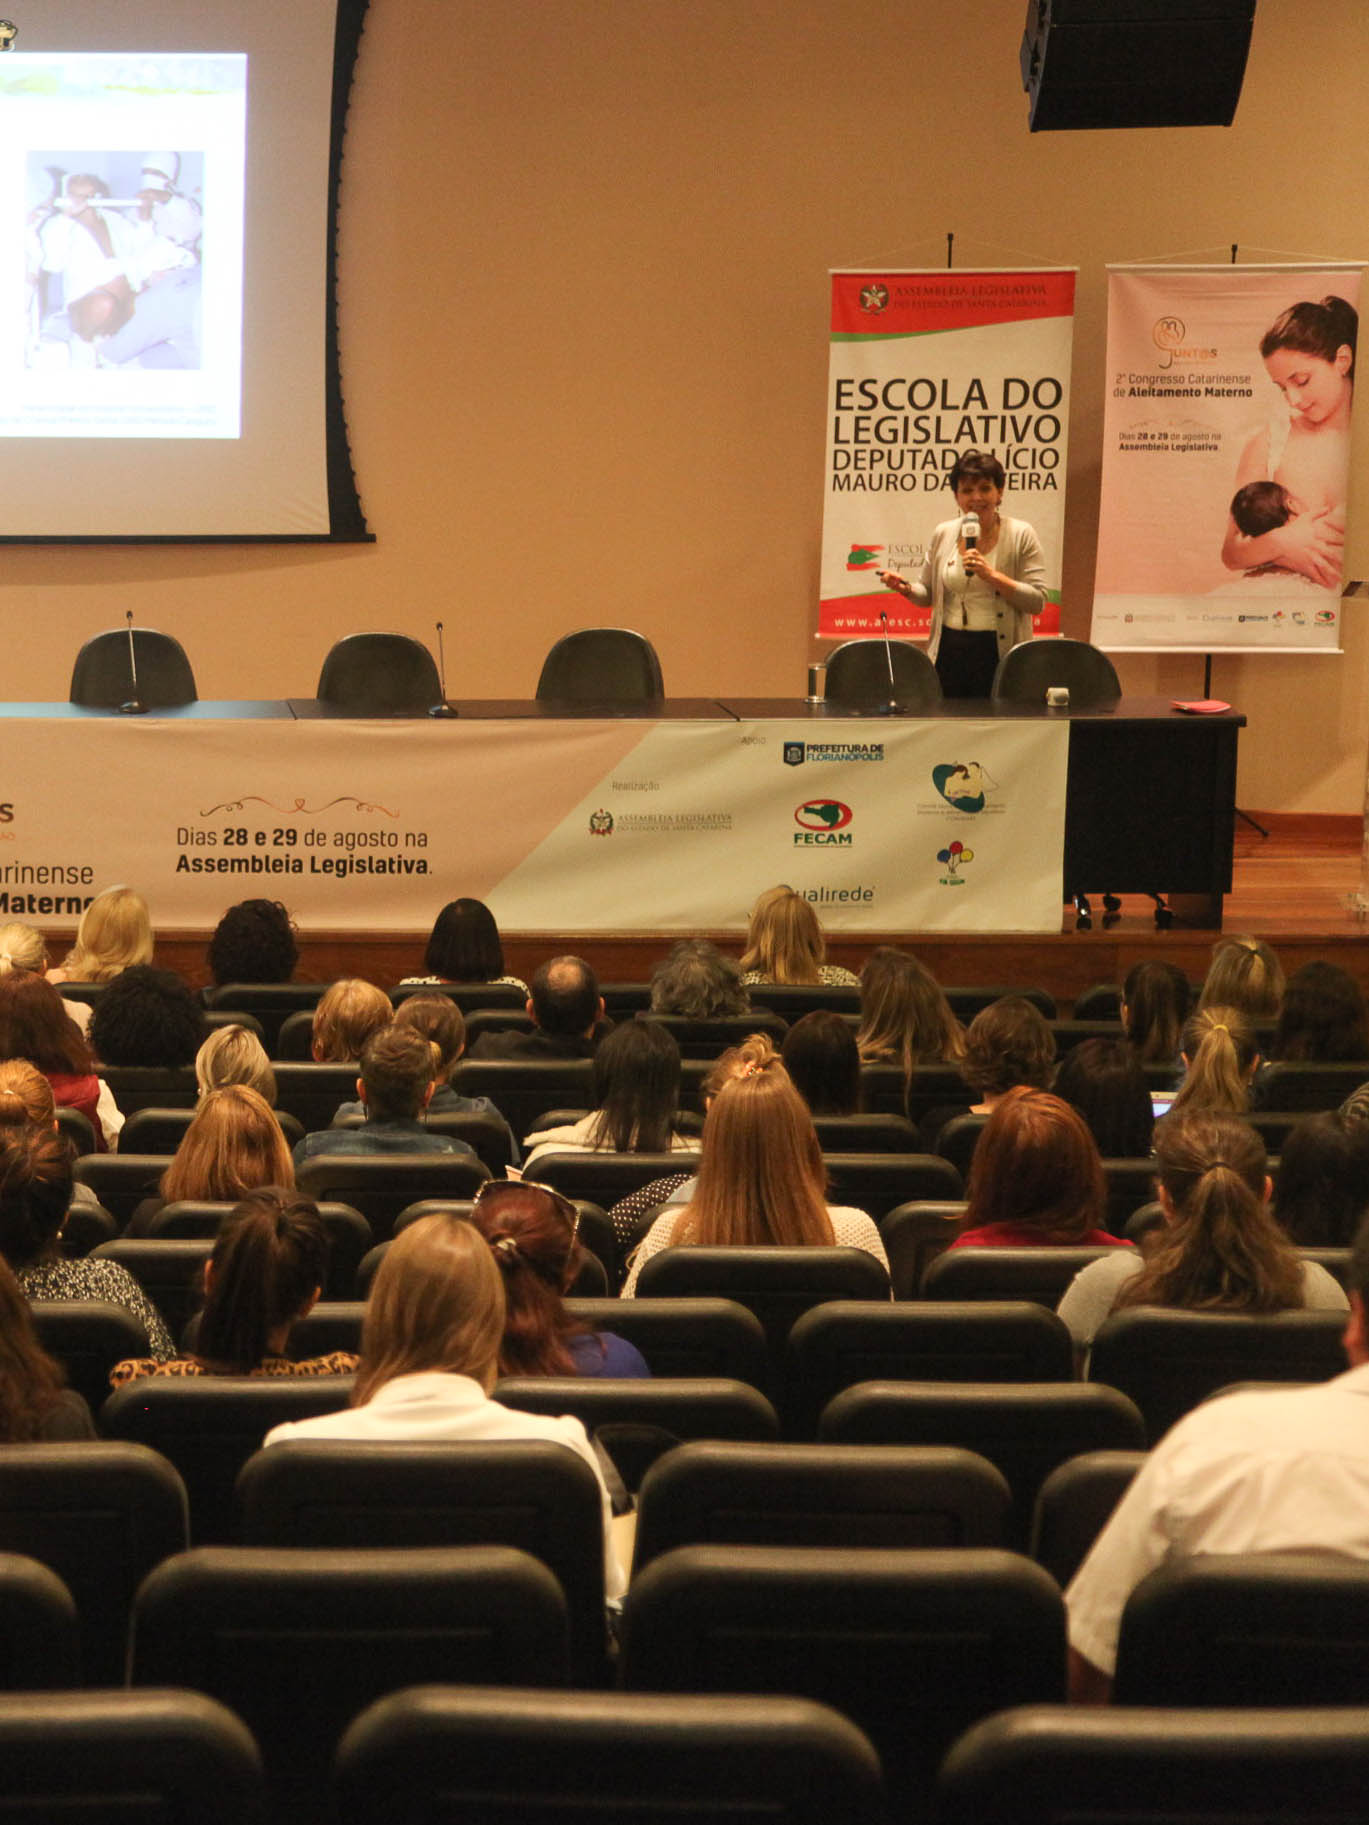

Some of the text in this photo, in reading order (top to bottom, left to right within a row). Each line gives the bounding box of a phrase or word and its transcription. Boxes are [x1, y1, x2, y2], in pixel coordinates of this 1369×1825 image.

[1128, 373, 1185, 386] Congresso
[1188, 373, 1252, 384] Catarinense
[835, 377, 1063, 411] ESCOLA DO
[1113, 386, 1253, 398] de Aleitamento Materno
[834, 414, 1062, 444] LEGISLATIVO
[1118, 442, 1169, 451] Assembleia
[833, 443, 1060, 471] DEPUTAD ÍCIO
[832, 472, 1058, 492] MAURO DA EIRA
[888, 543, 924, 554] ESCOL
[887, 557, 925, 572] Deputad
[806, 743, 885, 753] PREFEITURA DE
[176, 827, 429, 851] Dias 28 e 29 de agosto na
[793, 832, 853, 845] FECAM
[176, 853, 304, 875] Assembleia
[784, 884, 874, 902] ualirede
